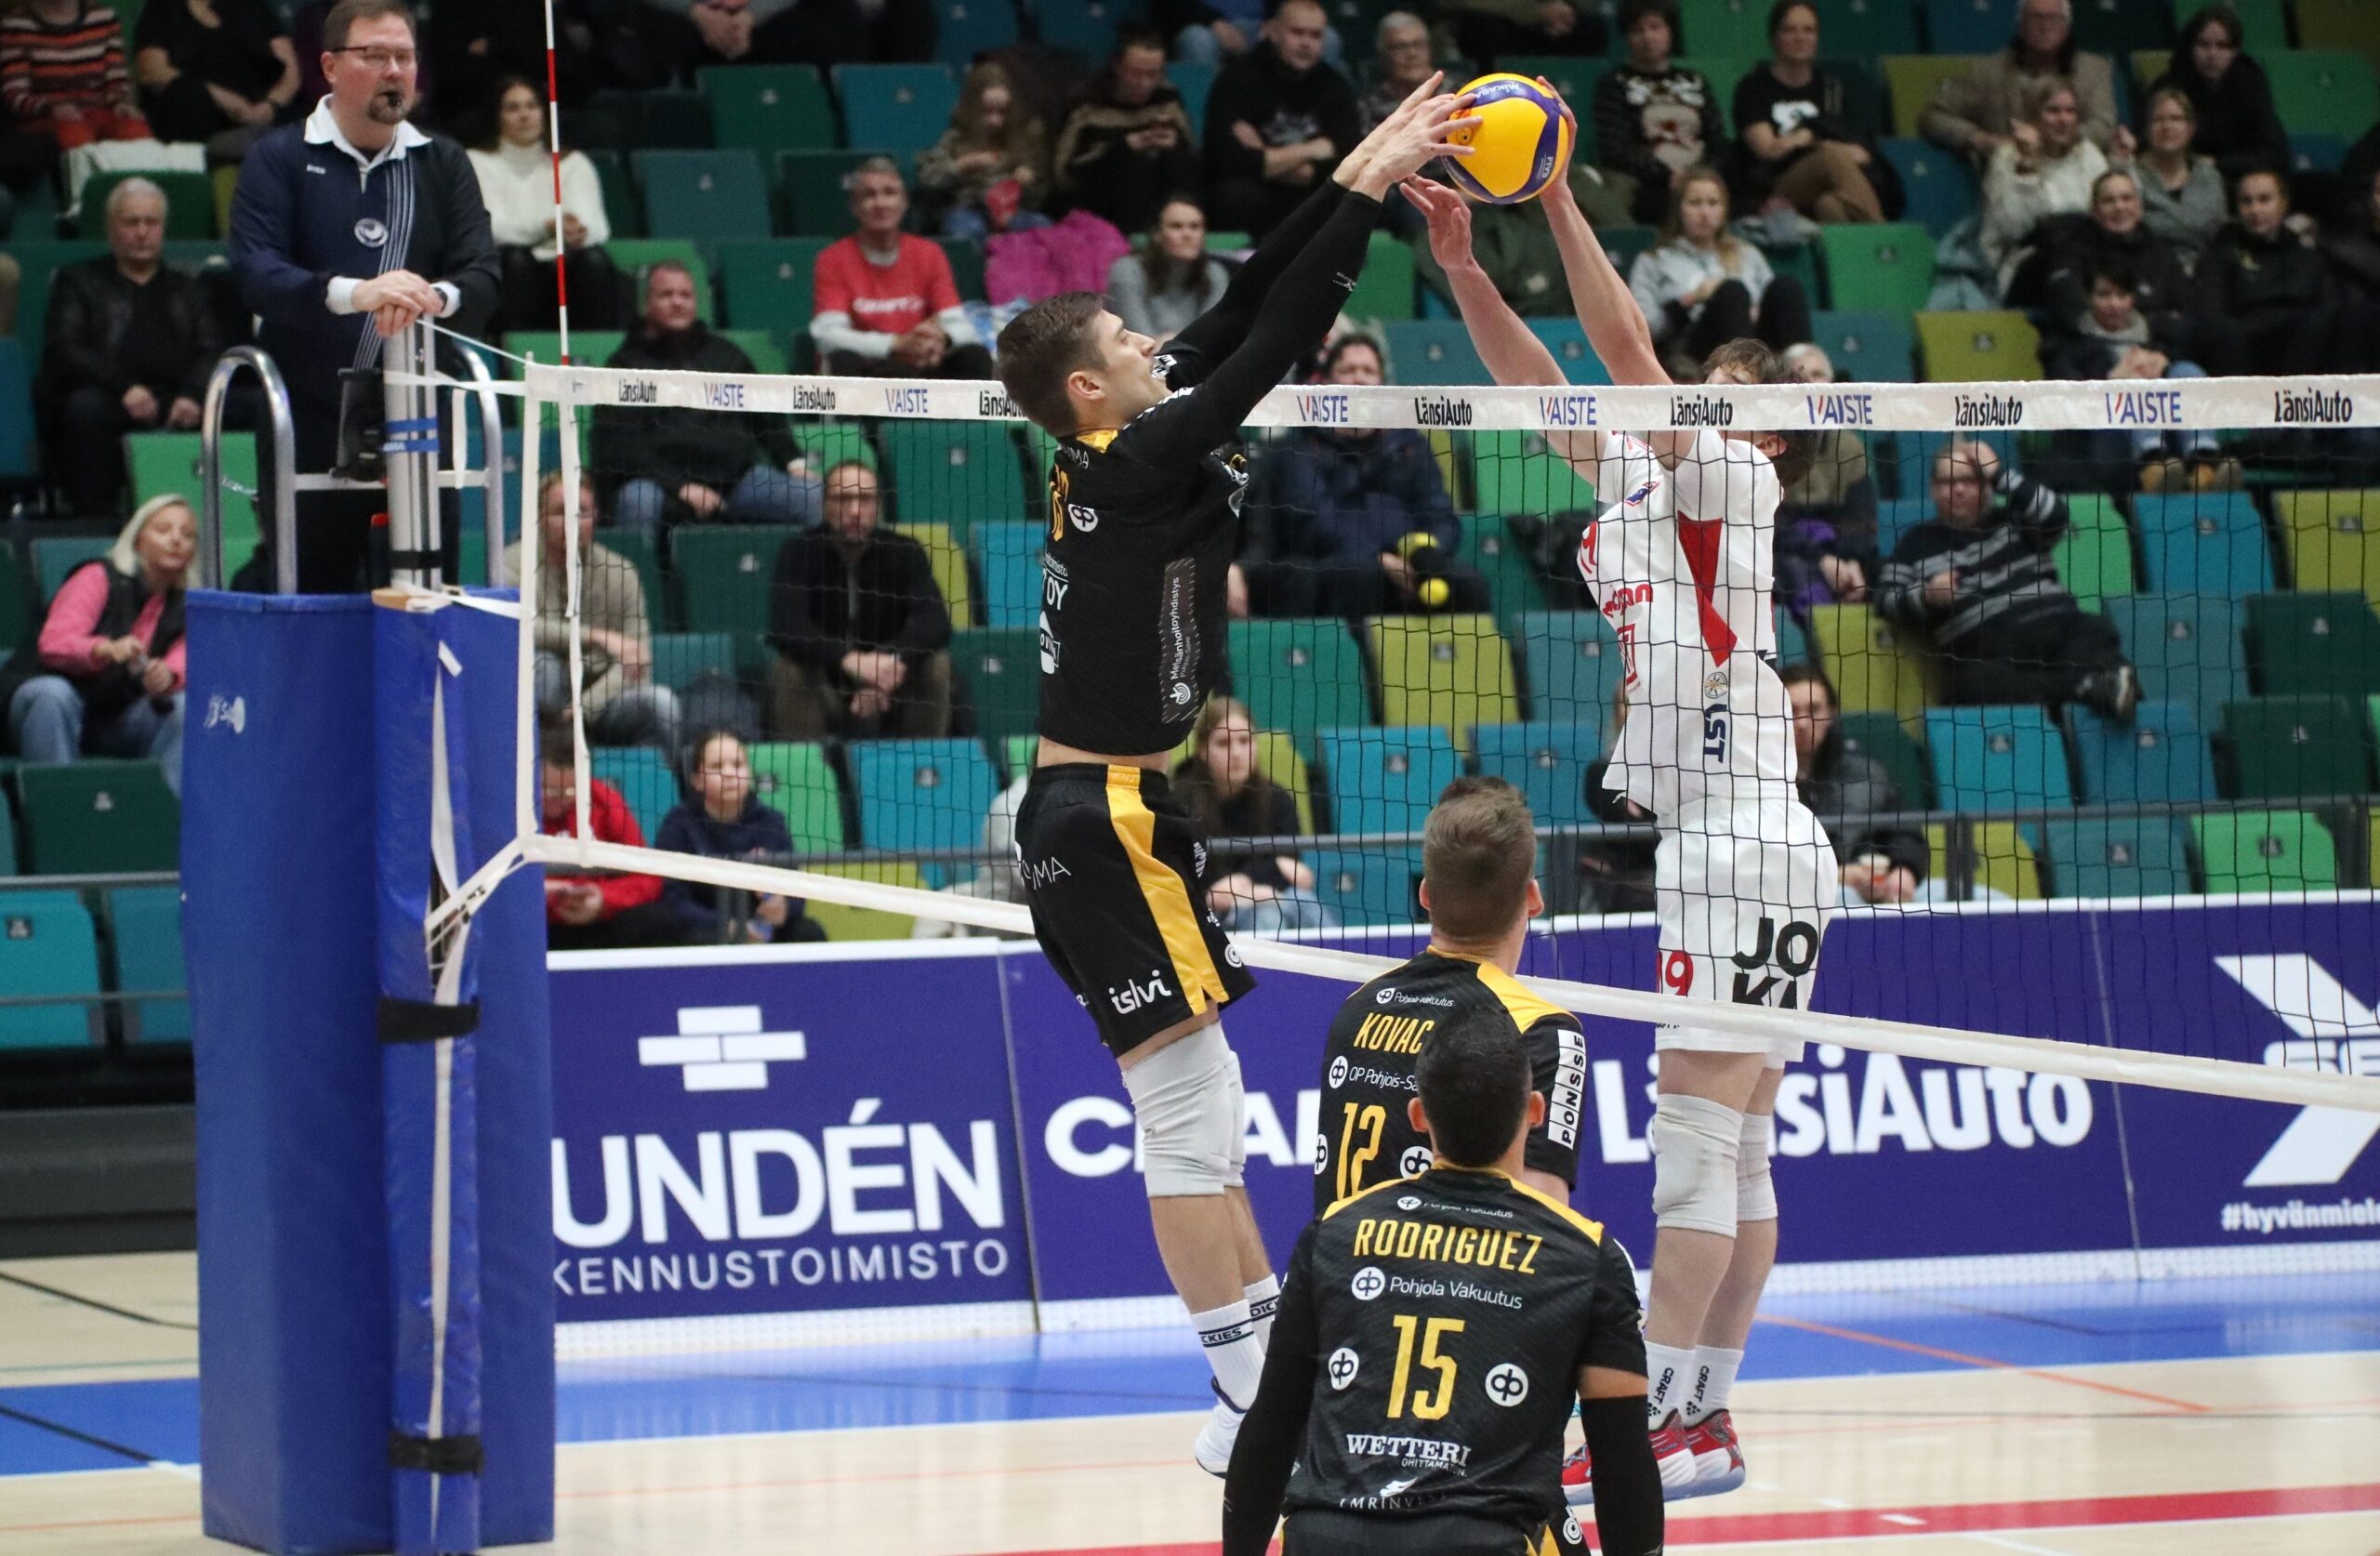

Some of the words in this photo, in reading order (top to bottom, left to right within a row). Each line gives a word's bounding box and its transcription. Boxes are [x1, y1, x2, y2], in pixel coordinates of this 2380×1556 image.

[704, 382, 744, 408] VAISTE
[793, 385, 836, 411] LänsiAuto
[885, 388, 928, 414] VAISTE
[979, 389, 1025, 418] LänsiAu
[1296, 394, 1348, 423] VAISTE
[1414, 395, 1473, 426] LänsiAuto
[1539, 396, 1597, 426] VAISTE
[1670, 393, 1733, 427] LänsiAuto
[1805, 394, 1873, 425] VAISTE
[1955, 393, 2023, 427] LänsiAuto
[2105, 390, 2182, 425] VAISTE
[2274, 386, 2352, 424] LänsiAuto
[1731, 916, 1818, 978] JO
[1354, 1012, 1435, 1055] KOVAC
[1349, 1067, 1362, 1082] OP
[1561, 1034, 1584, 1145] PONSSE
[1592, 1043, 2093, 1164] LsiAuto
[1336, 1102, 1386, 1200] 12
[1353, 1219, 1543, 1275] RODRIGUEZ
[1250, 1300, 1278, 1318] DIC
[1390, 1276, 1445, 1298] Pohjola
[1449, 1282, 1523, 1310] Vakuutus
[1387, 1314, 1465, 1421] 15
[1653, 1366, 1674, 1404] CRAFT
[1693, 1365, 1710, 1403] CRAFT
[1346, 1433, 1472, 1467] WETTERI
